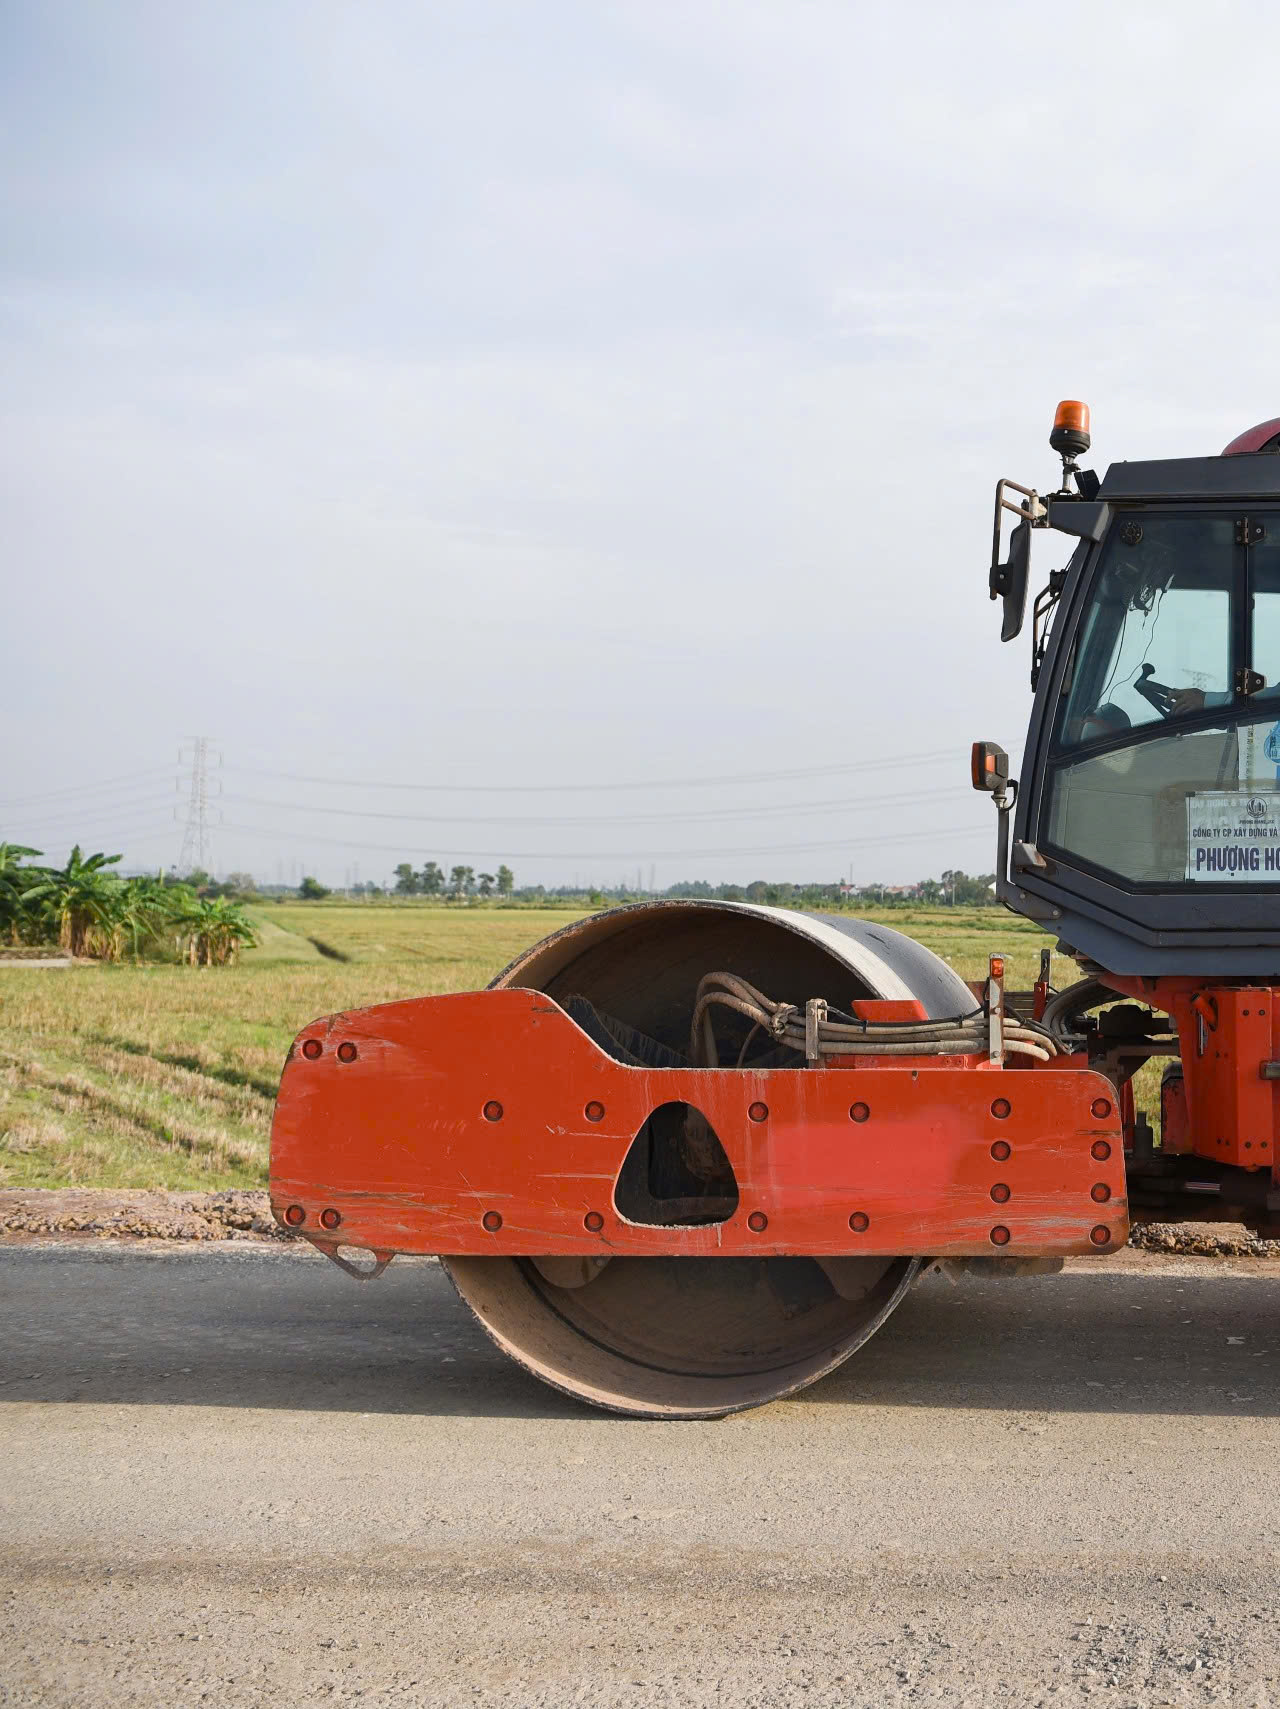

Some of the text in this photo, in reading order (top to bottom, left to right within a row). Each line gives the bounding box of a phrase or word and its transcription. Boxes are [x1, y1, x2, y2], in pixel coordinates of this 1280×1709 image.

[1192, 826, 1211, 838] CÔNG
[1212, 828, 1221, 838] TY
[1222, 828, 1232, 838] CP
[1233, 826, 1247, 838] XÂY
[1269, 826, 1278, 838] VÀ
[1196, 845, 1260, 877] PHƯỢNG
